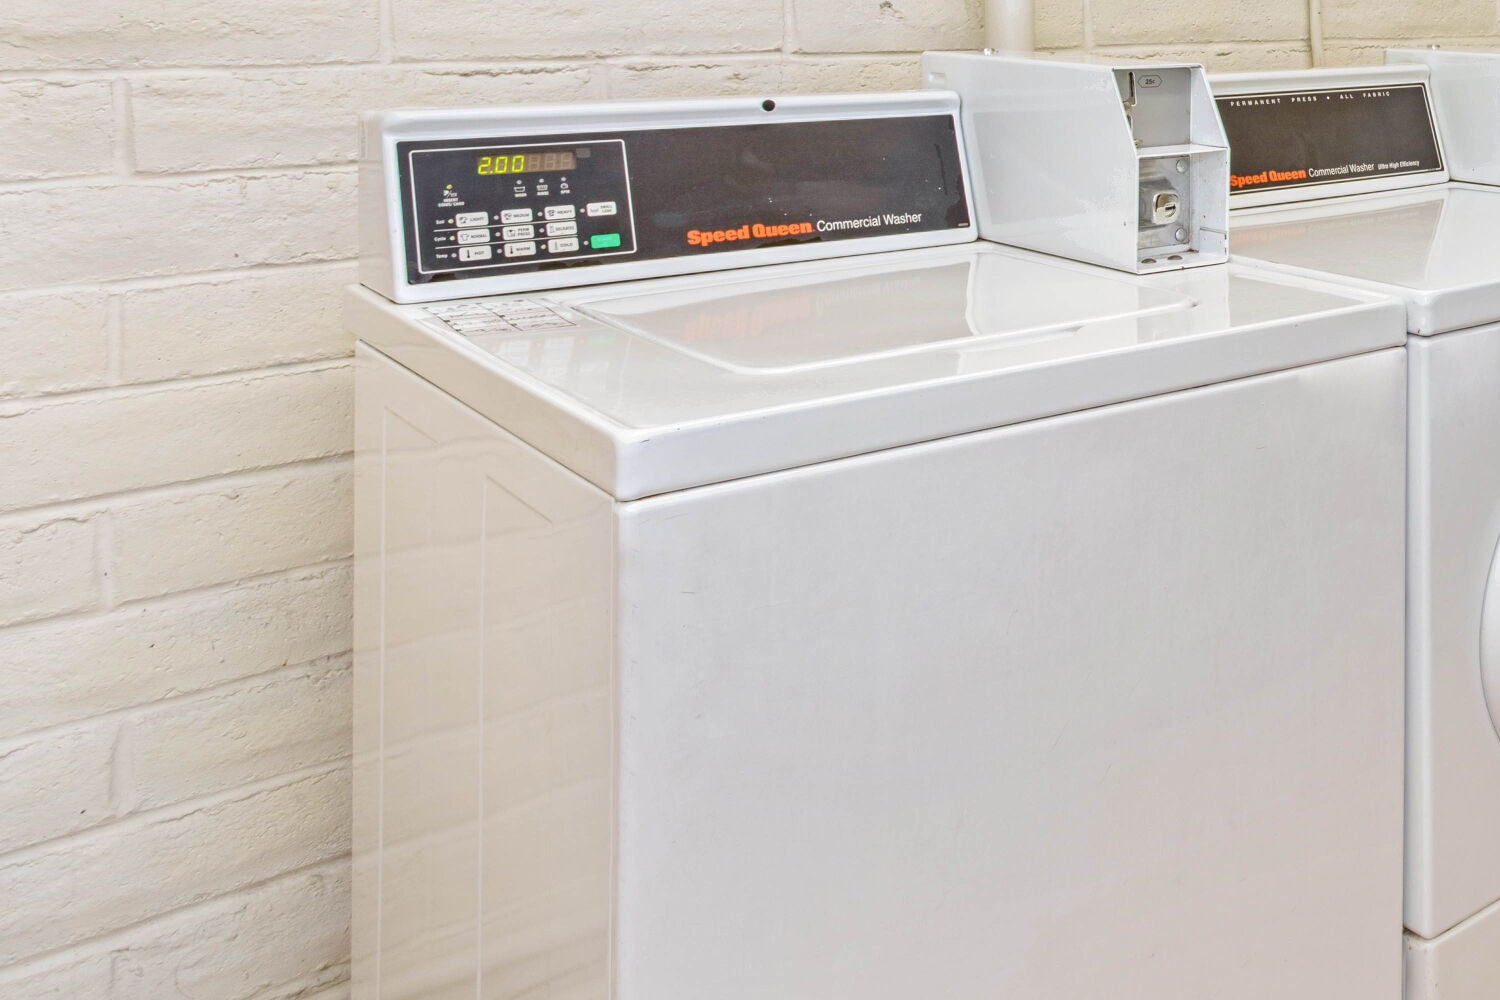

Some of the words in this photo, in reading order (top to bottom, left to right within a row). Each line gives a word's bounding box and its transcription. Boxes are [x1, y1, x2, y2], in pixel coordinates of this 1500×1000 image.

[1230, 98, 1281, 107] PERMANENT
[1363, 91, 1391, 99] FABRIC
[477, 155, 525, 175] 2.00
[1230, 170, 1268, 188] Speed
[1269, 168, 1307, 183] Queen
[1308, 164, 1349, 177] Commercial
[1349, 162, 1375, 174] Washer
[687, 224, 751, 247] Speed
[752, 221, 813, 239] Queen
[816, 215, 881, 232] Commercial
[882, 212, 923, 226] Washer
